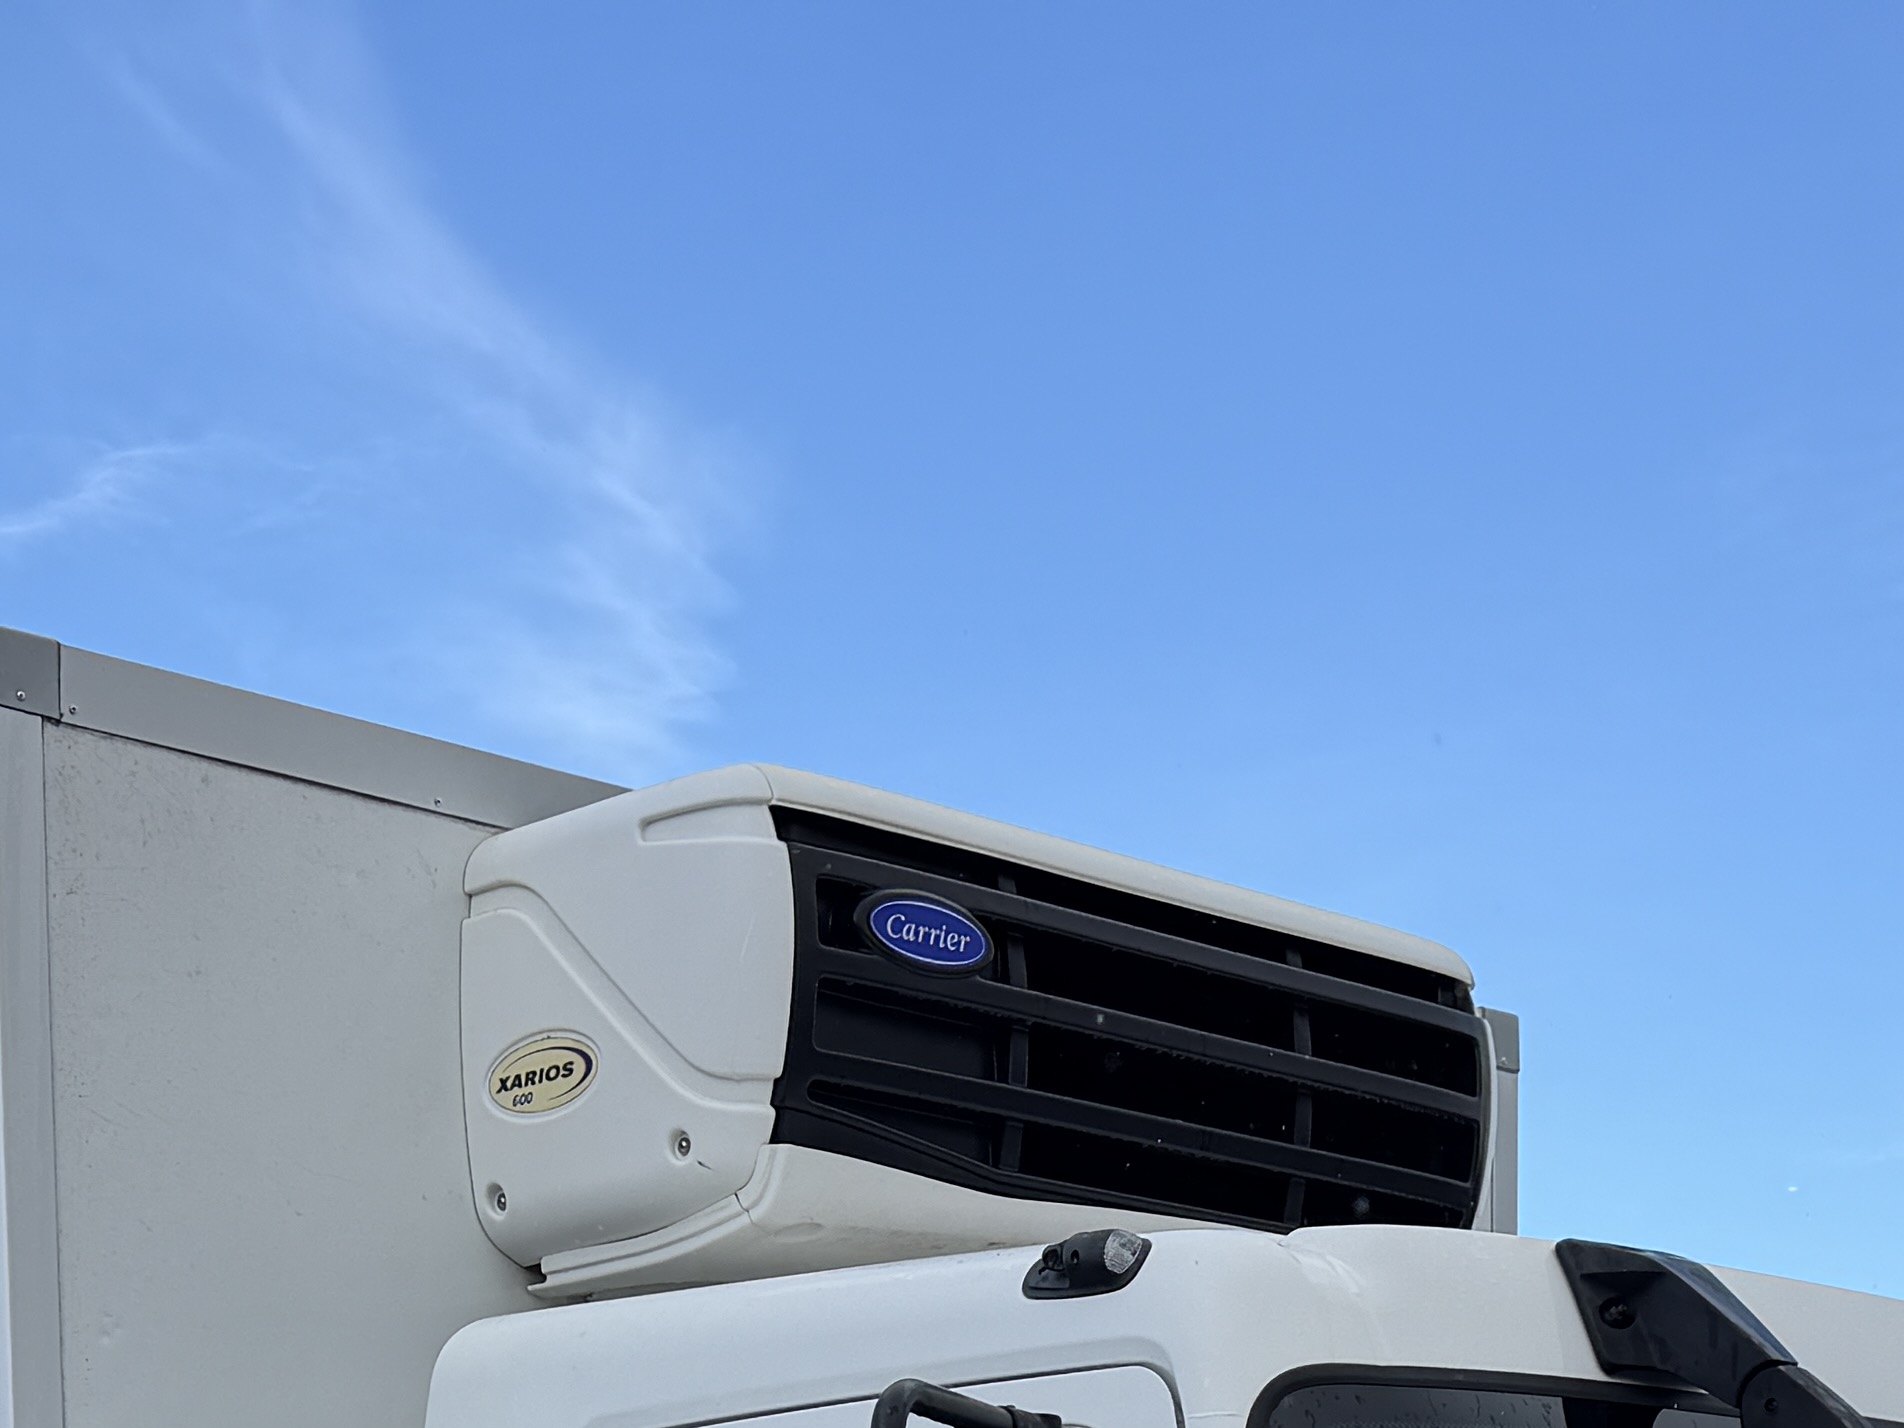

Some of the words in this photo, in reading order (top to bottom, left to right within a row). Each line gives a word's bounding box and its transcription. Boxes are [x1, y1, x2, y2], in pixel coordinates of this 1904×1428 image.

[886, 914, 970, 952] Carrier
[496, 1061, 574, 1094] XARIOS
[512, 1092, 533, 1107] 600
